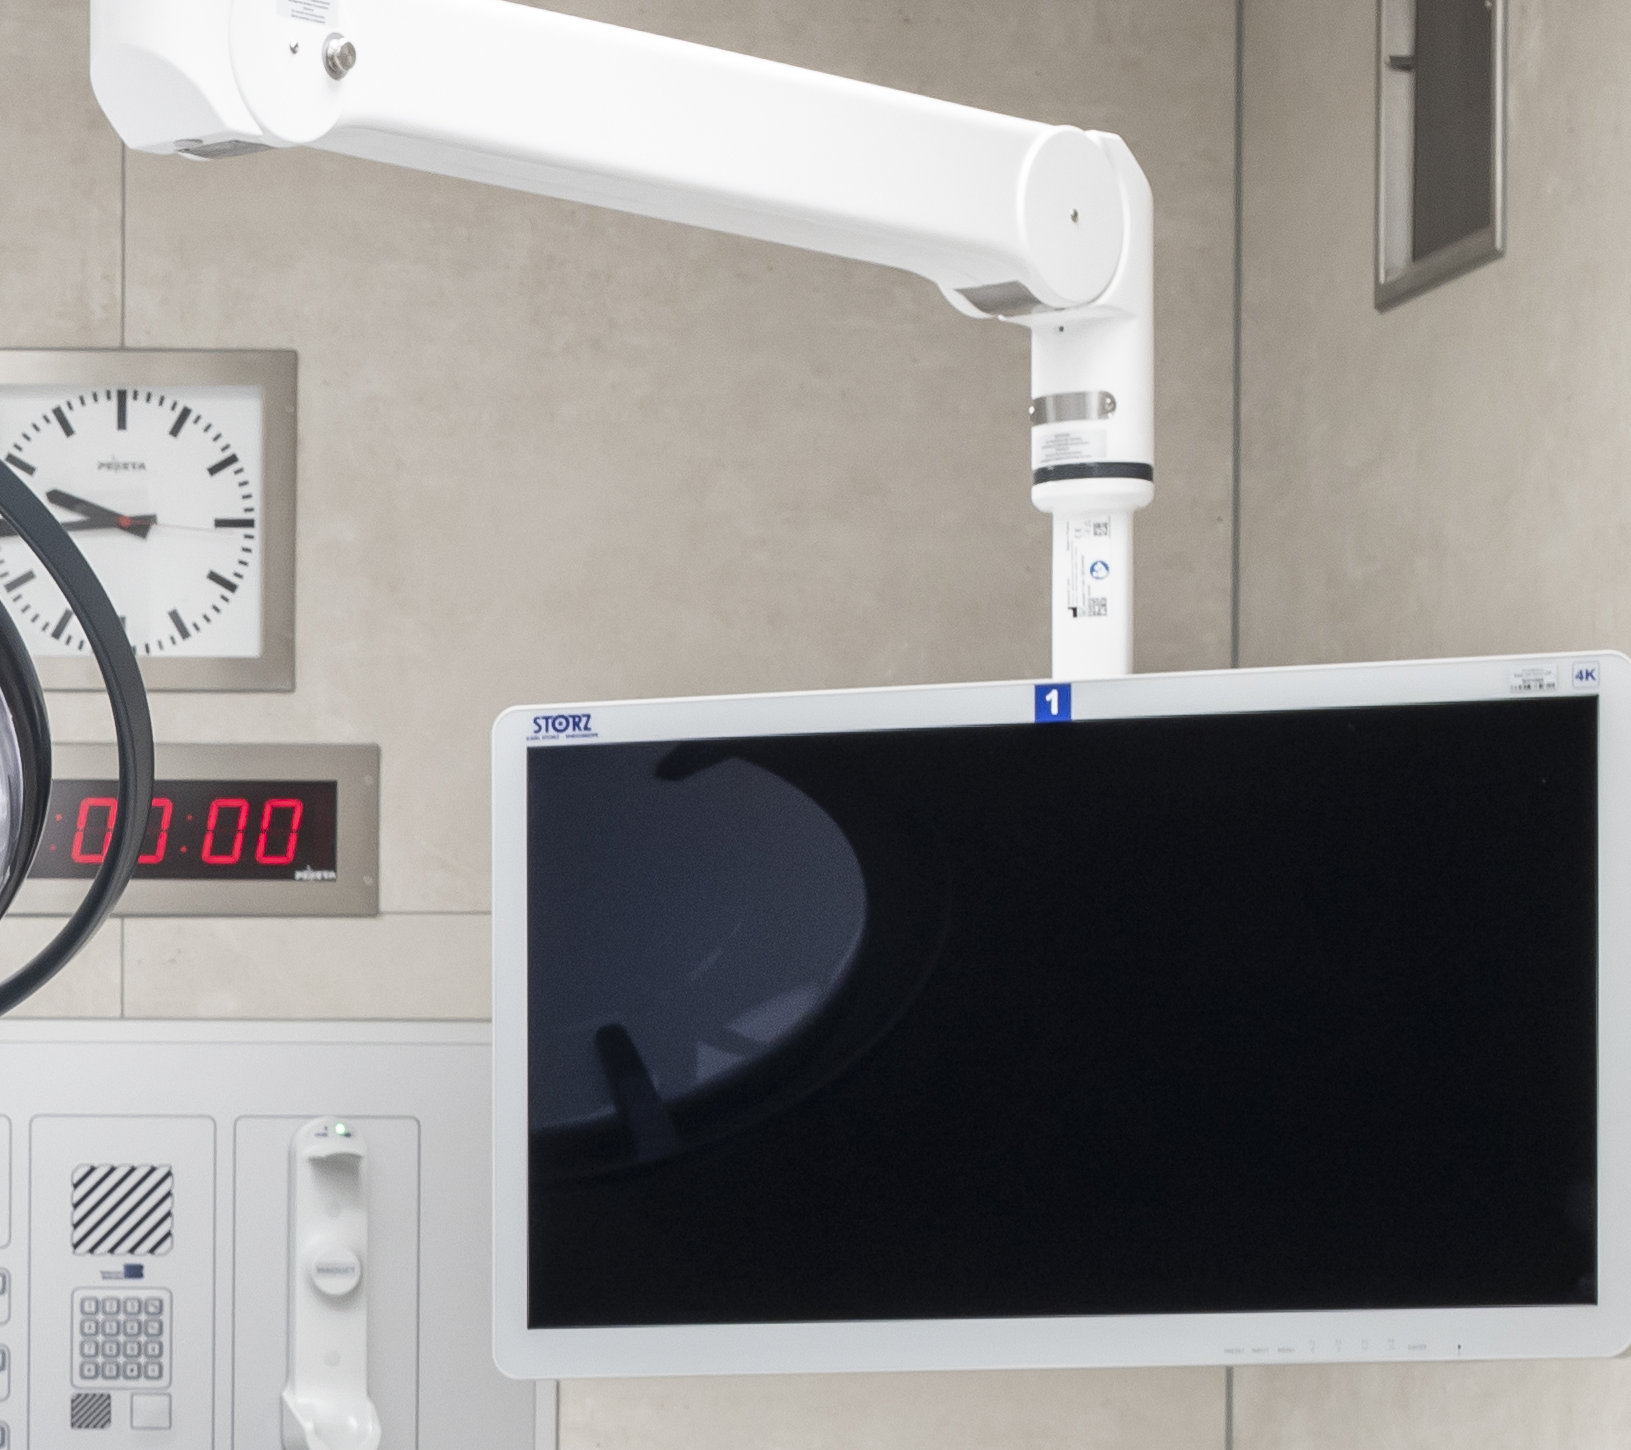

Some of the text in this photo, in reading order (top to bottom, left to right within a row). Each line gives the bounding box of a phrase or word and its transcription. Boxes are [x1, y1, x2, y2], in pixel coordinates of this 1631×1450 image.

[1575, 668, 1597, 681] 4K
[1045, 688, 1059, 716] 1
[533, 713, 592, 733] STORZ
